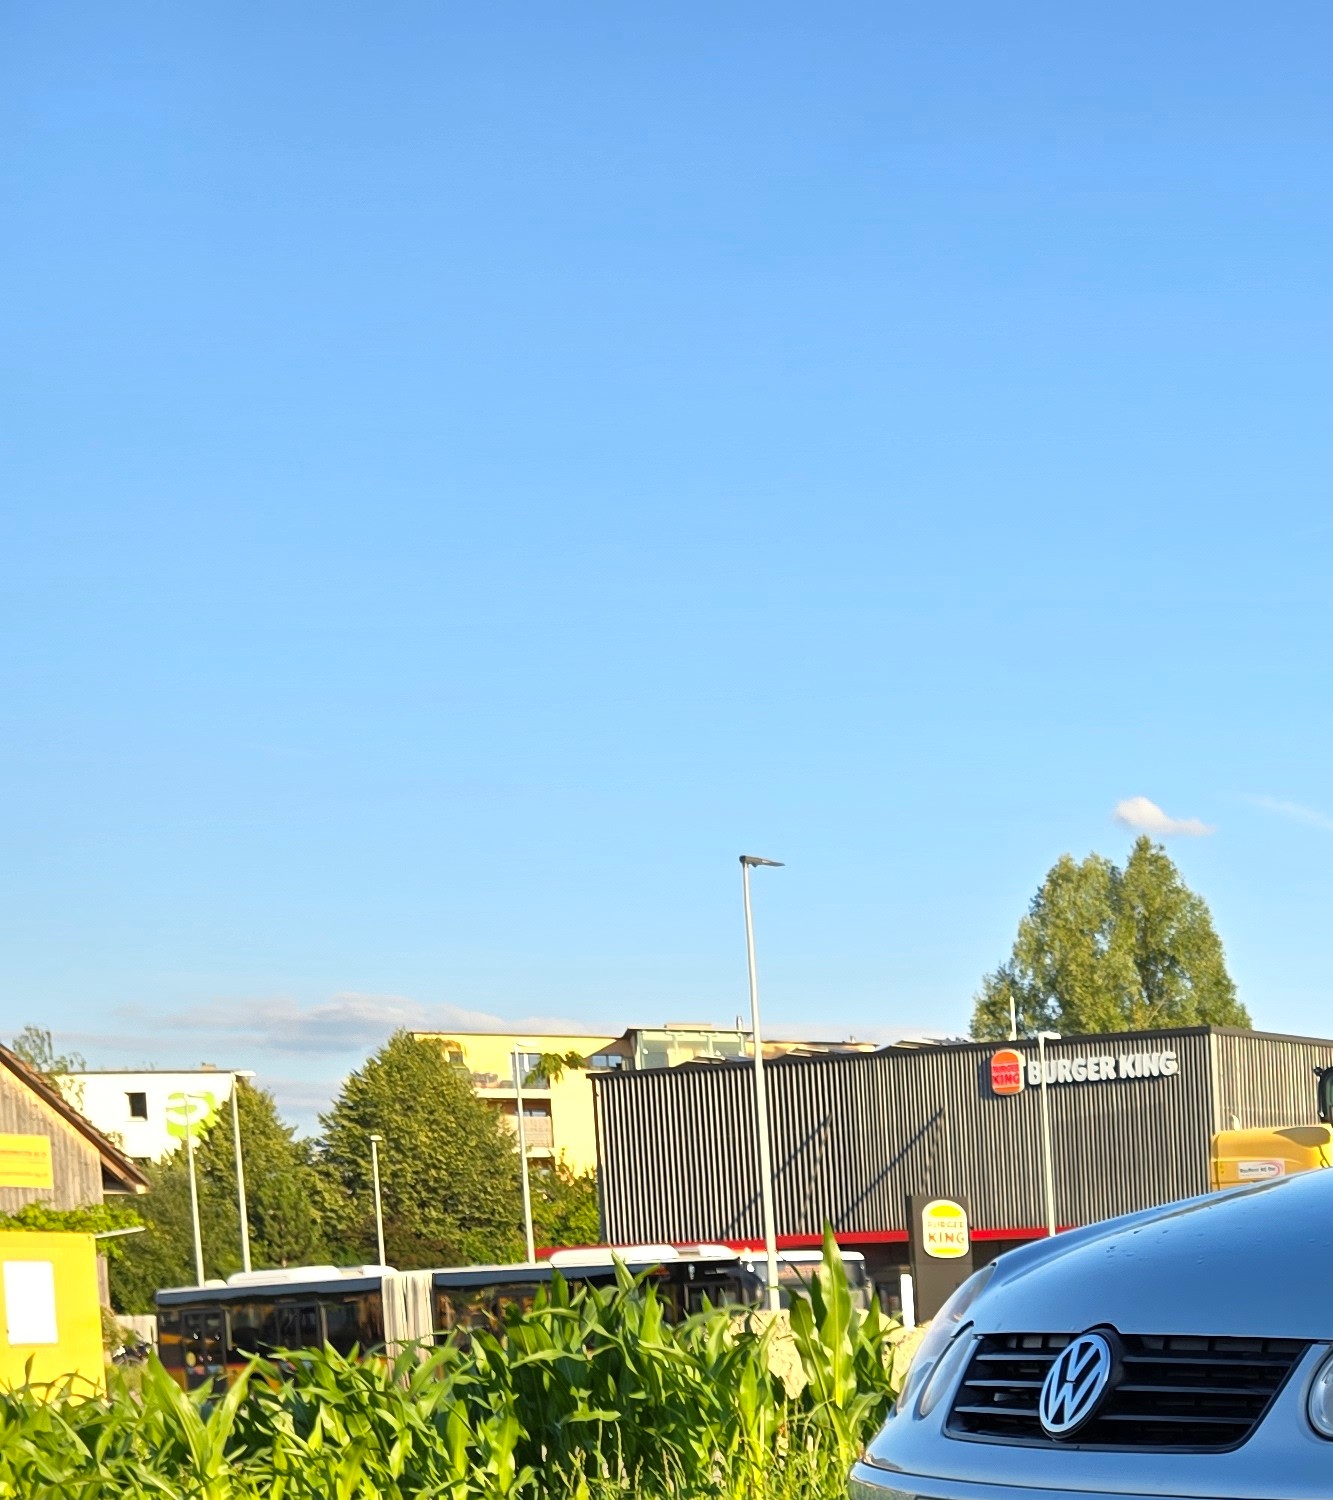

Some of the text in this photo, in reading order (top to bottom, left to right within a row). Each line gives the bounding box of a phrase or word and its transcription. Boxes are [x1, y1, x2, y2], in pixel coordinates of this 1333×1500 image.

[993, 1073, 1020, 1085] KING
[1028, 1051, 1178, 1086] BURGER KING
[929, 1232, 965, 1243] KING
[1039, 1334, 1110, 1433] VW
